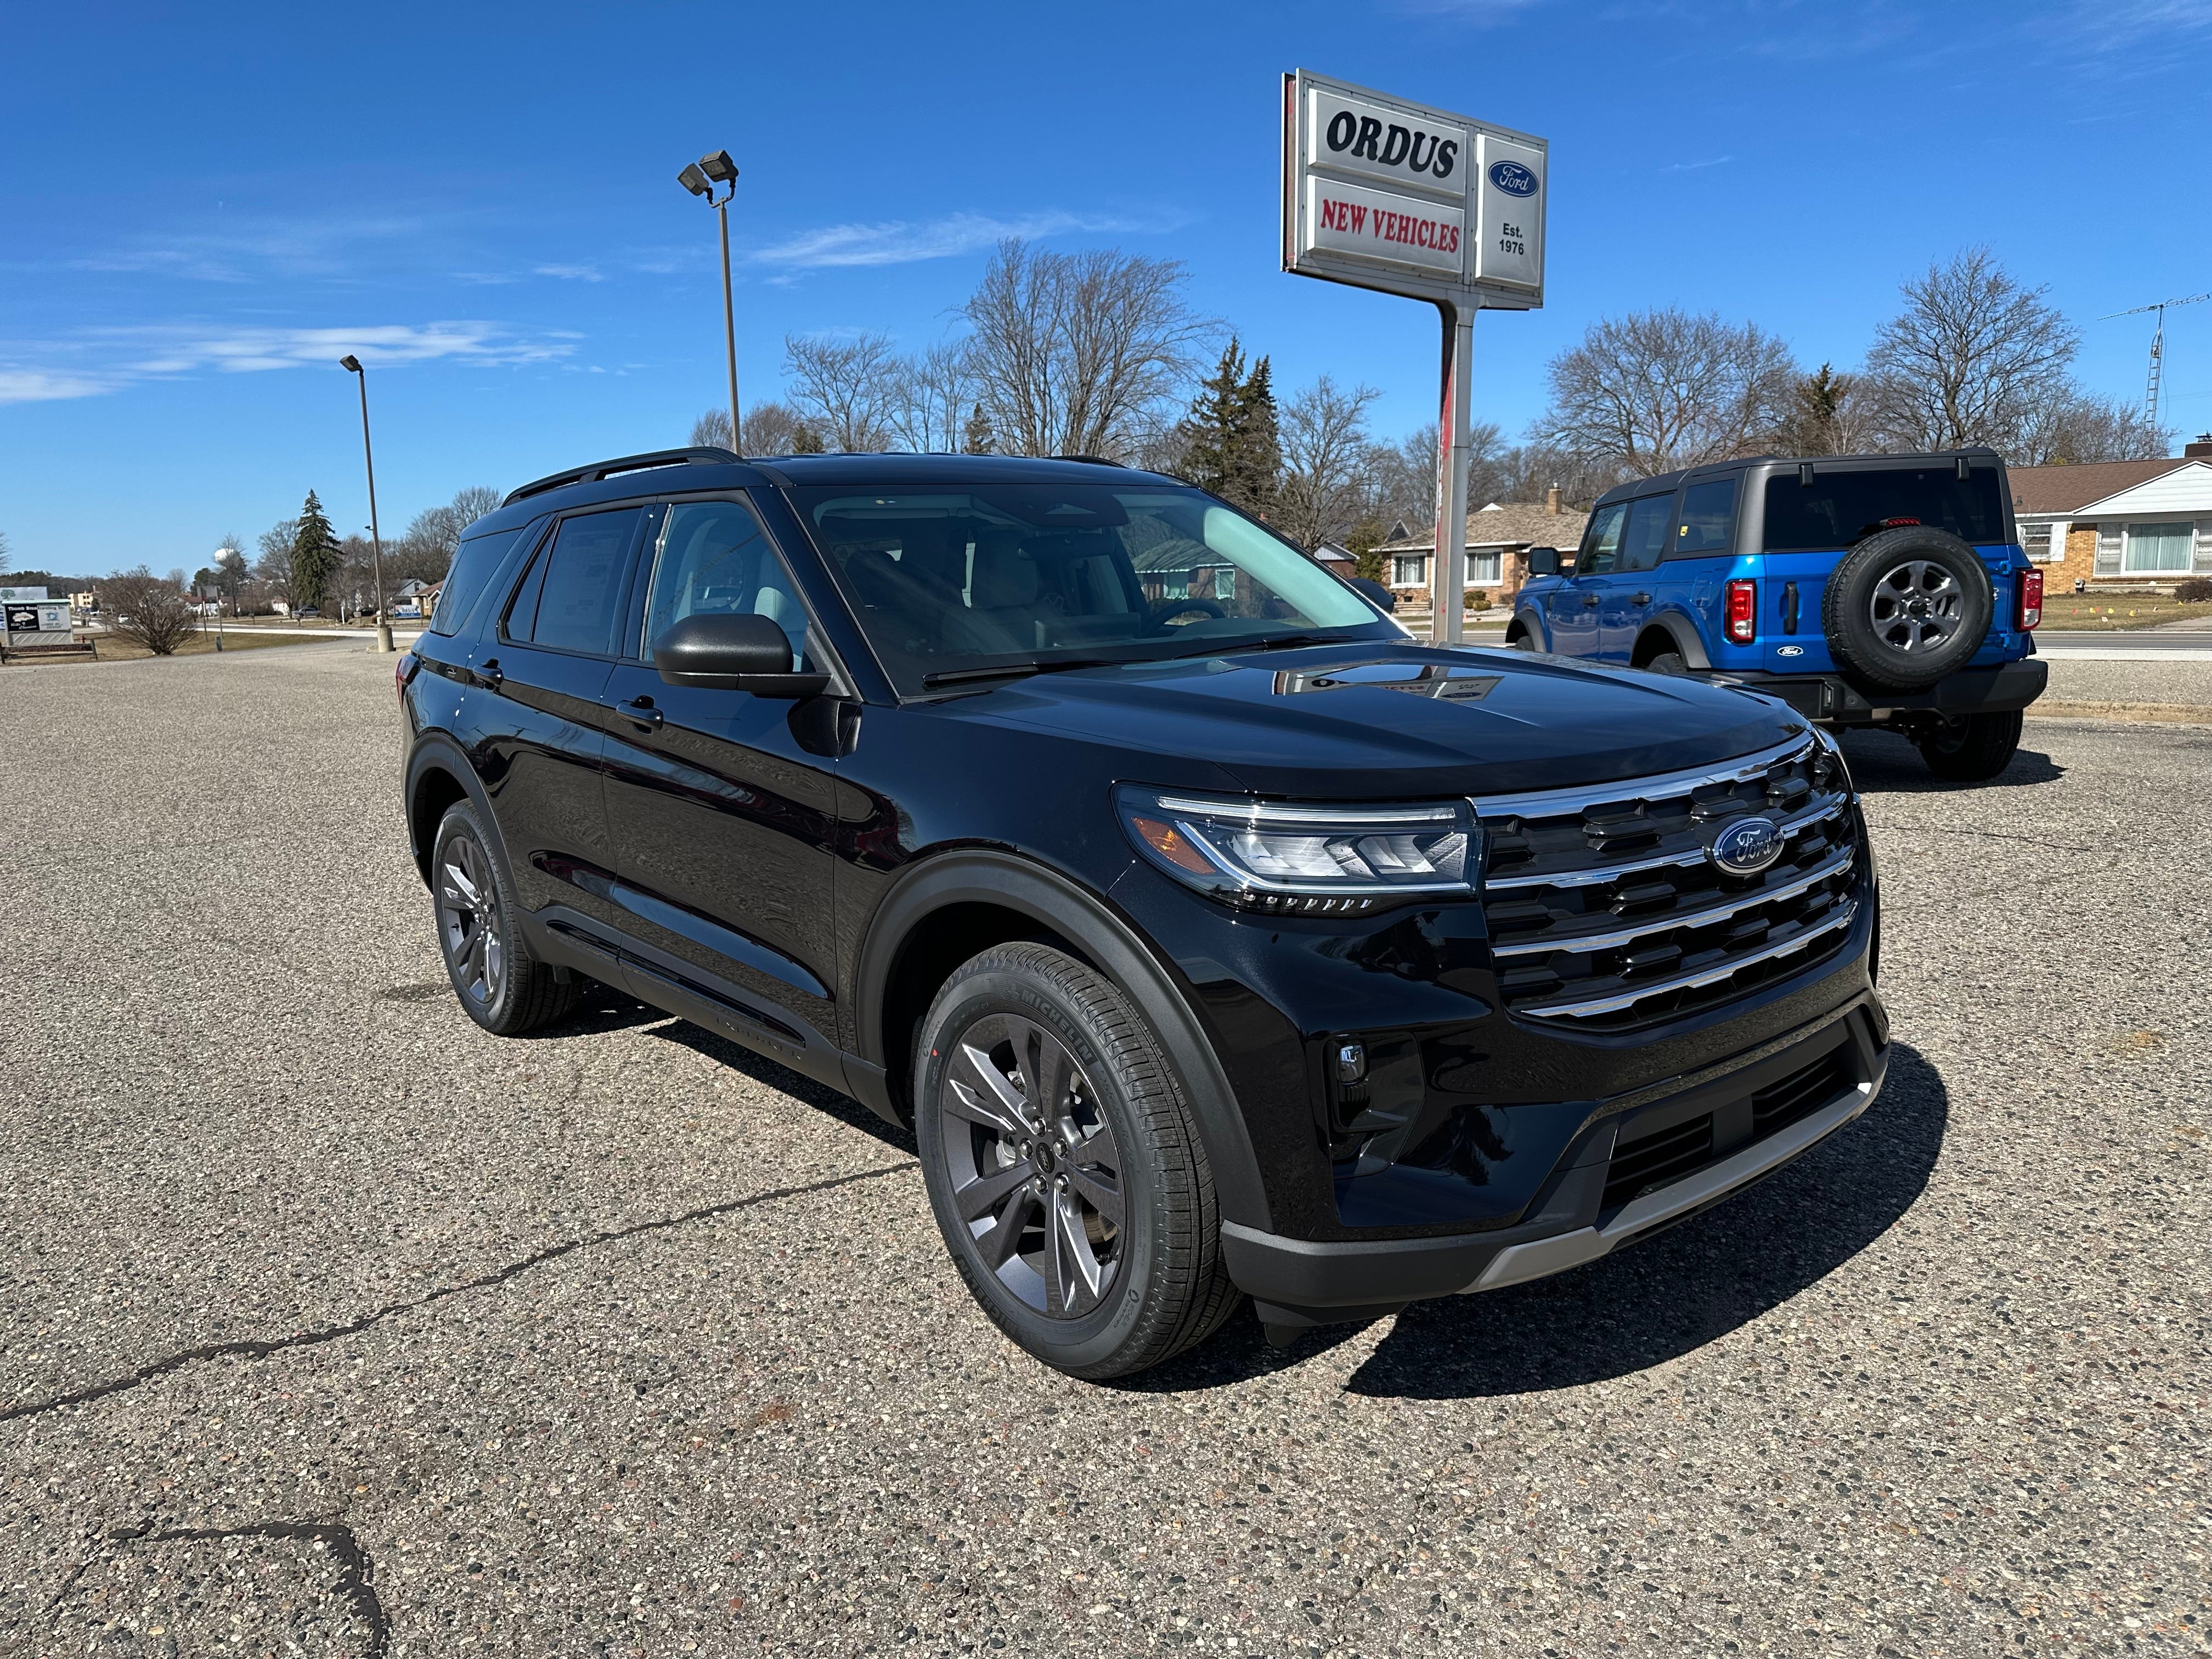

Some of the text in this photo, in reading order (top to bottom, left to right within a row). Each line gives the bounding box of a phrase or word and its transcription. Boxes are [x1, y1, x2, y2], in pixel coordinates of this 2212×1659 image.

[1327, 111, 1458, 178] ORDUS
[1498, 165, 1530, 191] Ford
[1321, 199, 1459, 253] NEW VEHICLES
[1503, 223, 1523, 239] Est.
[1498, 239, 1525, 256] 1976
[1736, 829, 1773, 862] Ford
[1021, 989, 1093, 1062] MICHELIN
